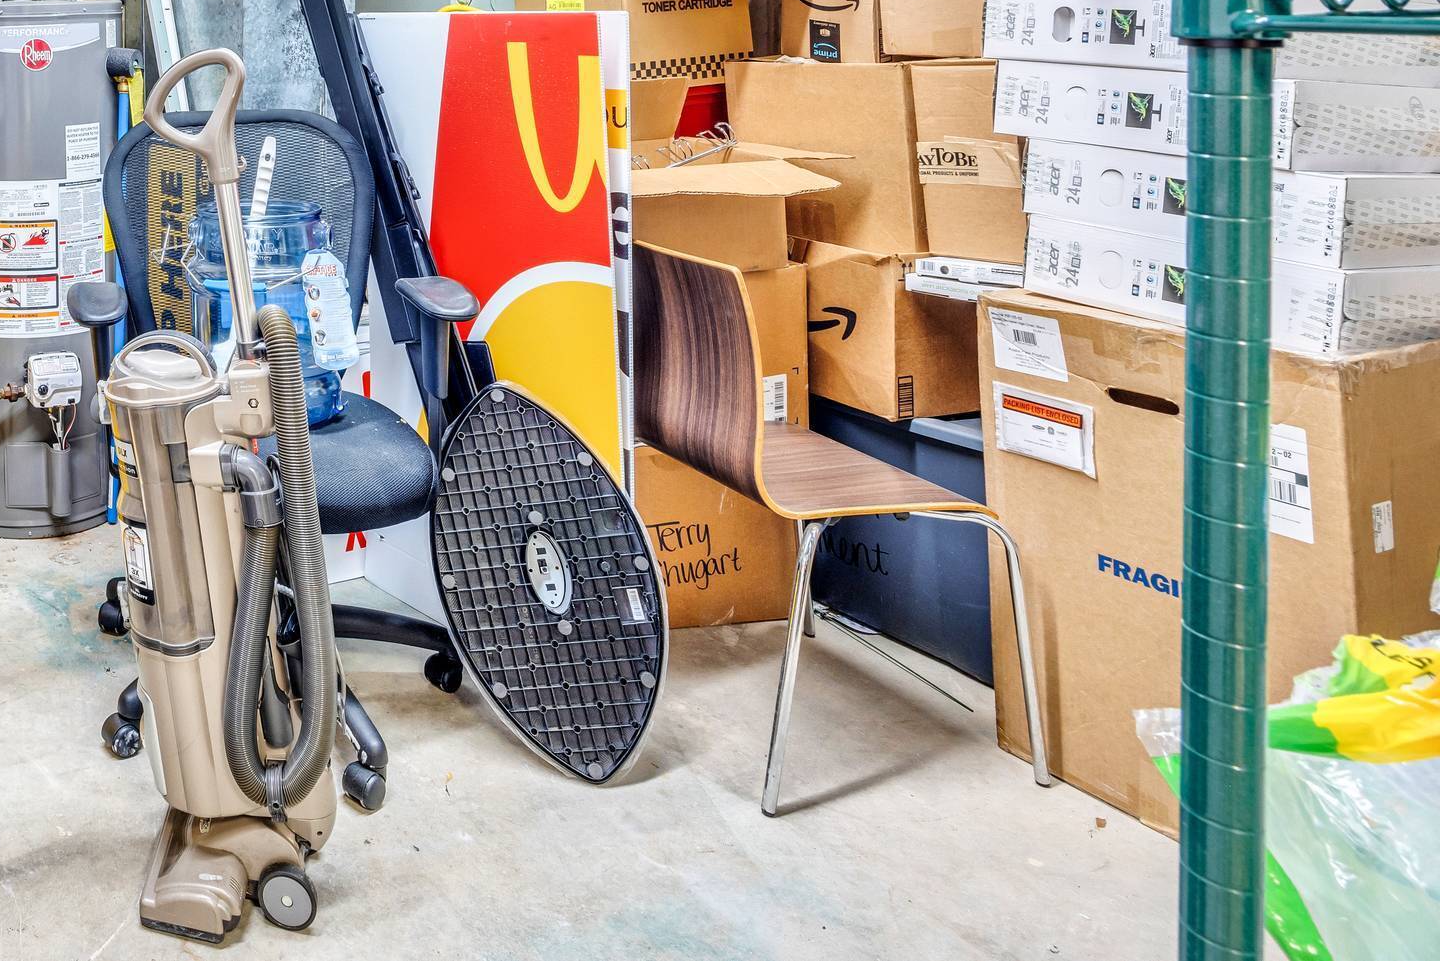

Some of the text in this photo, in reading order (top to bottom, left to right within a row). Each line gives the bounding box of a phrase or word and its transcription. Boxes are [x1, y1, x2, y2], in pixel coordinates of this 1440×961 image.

[642, 0, 677, 14] TONER
[1006, 11, 1016, 39] acer
[1022, 30, 1034, 46] 24
[24, 40, 51, 65] Rheem
[813, 48, 838, 59] prime
[1019, 87, 1029, 117] acer
[1035, 107, 1048, 125] 24
[1049, 162, 1060, 196] acer
[1067, 186, 1080, 205] 24
[1048, 242, 1060, 276] acer
[1066, 267, 1079, 287] 24
[1004, 397, 1079, 424] PACKING LIST ENCLOSED
[646, 521, 710, 556] Terry
[1097, 553, 1182, 597] FRAGI
